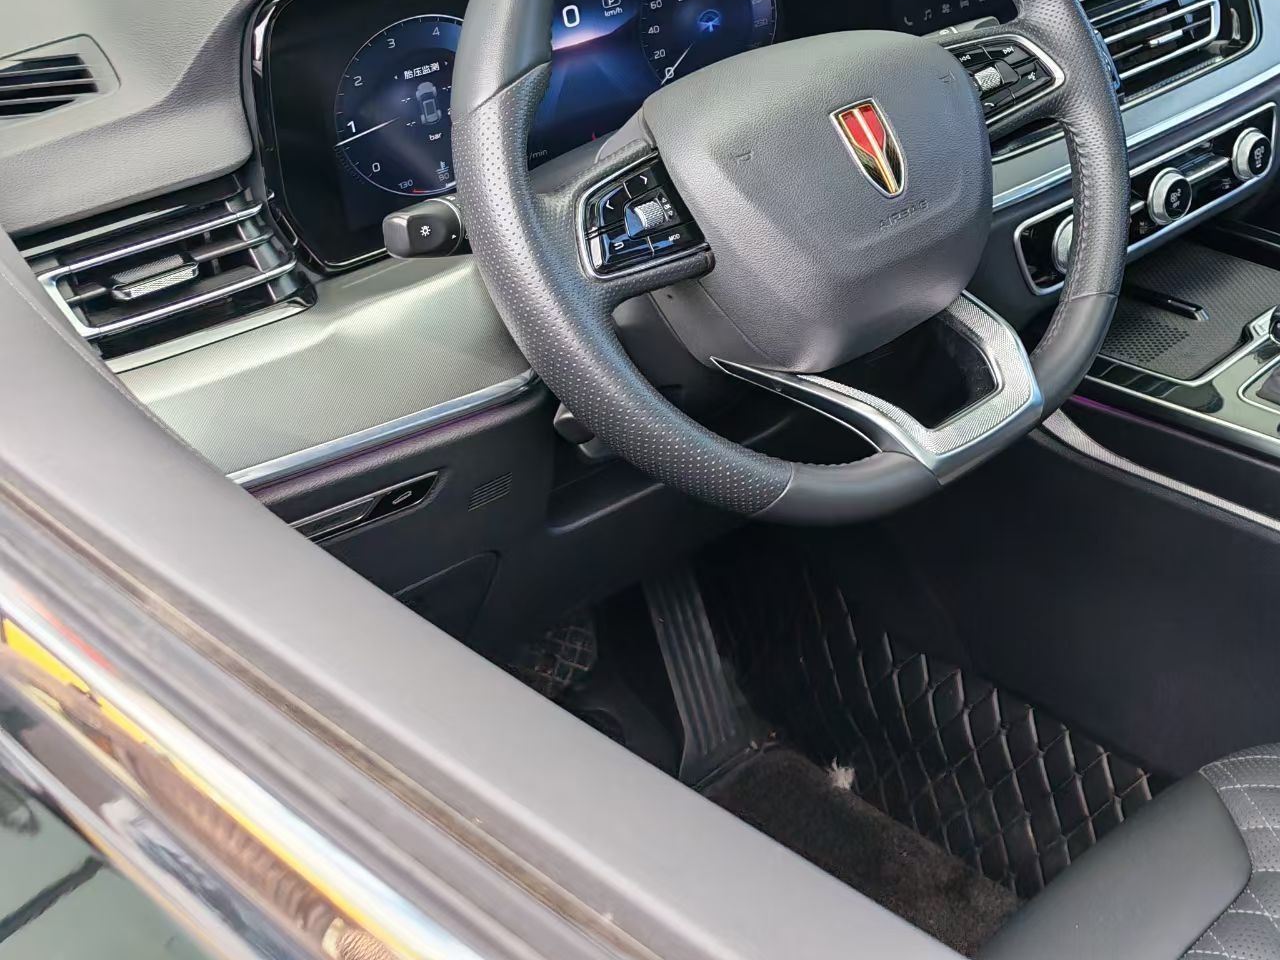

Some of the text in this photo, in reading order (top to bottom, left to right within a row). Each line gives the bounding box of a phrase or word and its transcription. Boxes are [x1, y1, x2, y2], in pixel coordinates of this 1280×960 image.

[650, 0, 663, 10] 60
[562, 4, 581, 28] 0
[604, 6, 623, 18] km/h
[432, 26, 440, 36] 4
[648, 24, 660, 34] 40
[387, 38, 396, 49] 3
[653, 48, 666, 60] 20
[403, 61, 441, 80] 胎压监测
[353, 75, 363, 87] 2
[346, 120, 356, 133] 1
[428, 132, 442, 141] bar
[371, 162, 380, 173] 0
[398, 179, 414, 190] 130
